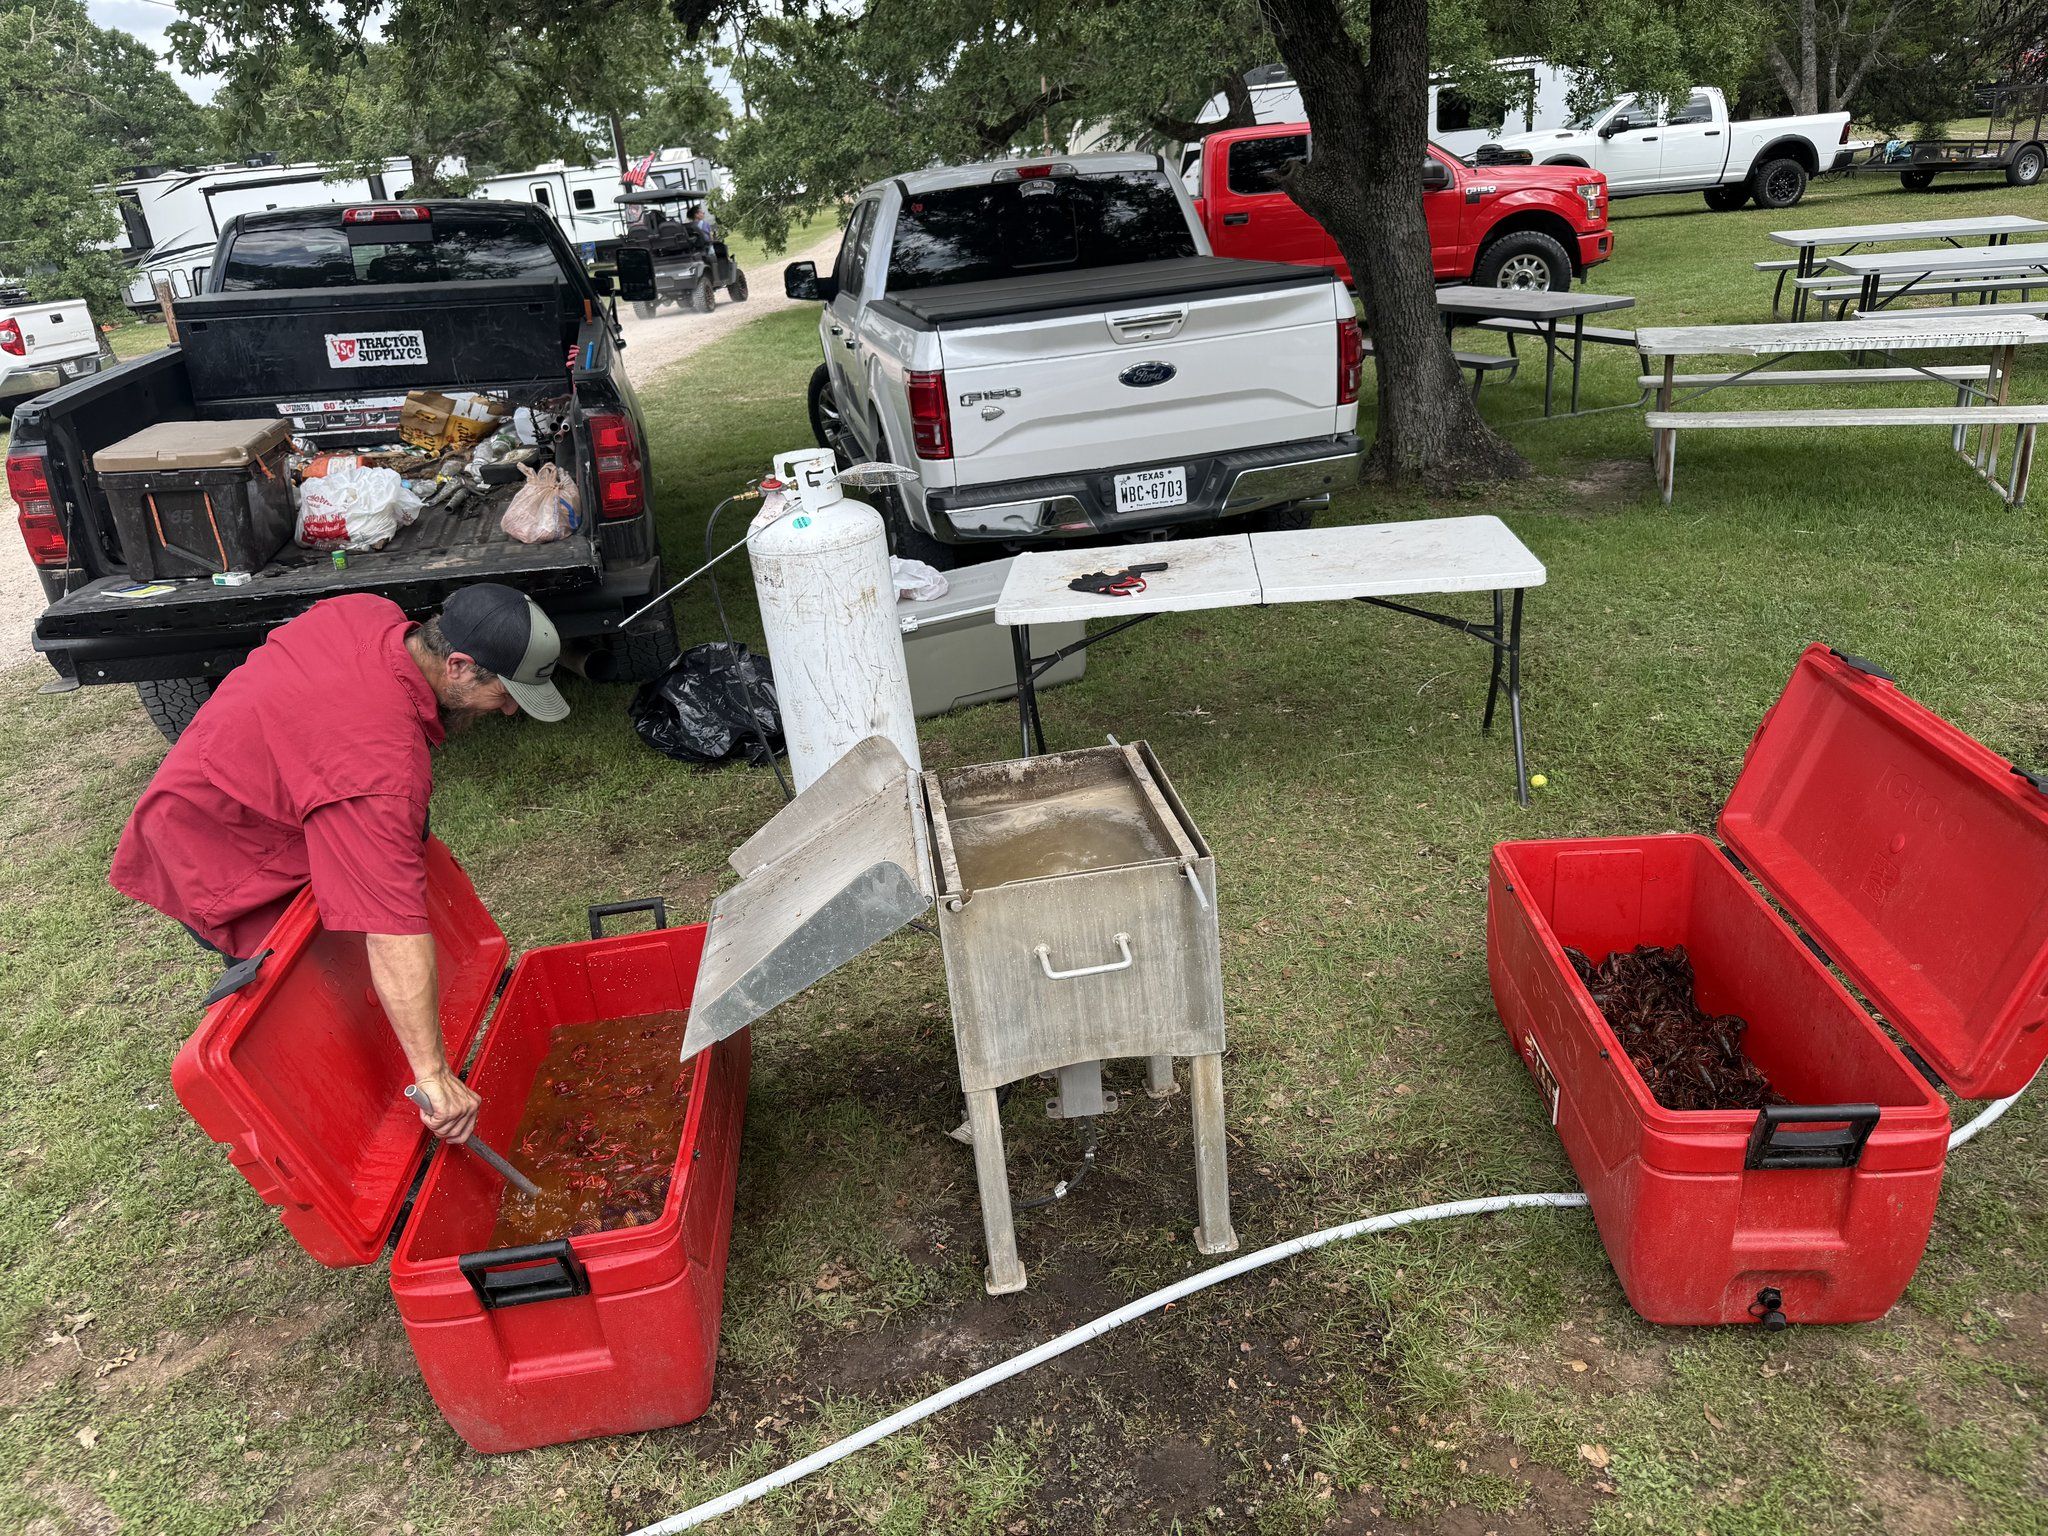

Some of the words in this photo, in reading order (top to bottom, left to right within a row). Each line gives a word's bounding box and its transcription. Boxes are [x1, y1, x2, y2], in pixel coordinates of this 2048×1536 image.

[333, 340, 354, 358] TSC
[356, 335, 420, 350] TRACTOR
[358, 348, 406, 362] SUPPLY
[959, 387, 1022, 407] F150
[1137, 471, 1165, 482] TEXAS
[1875, 762, 1967, 842] IGLOO
